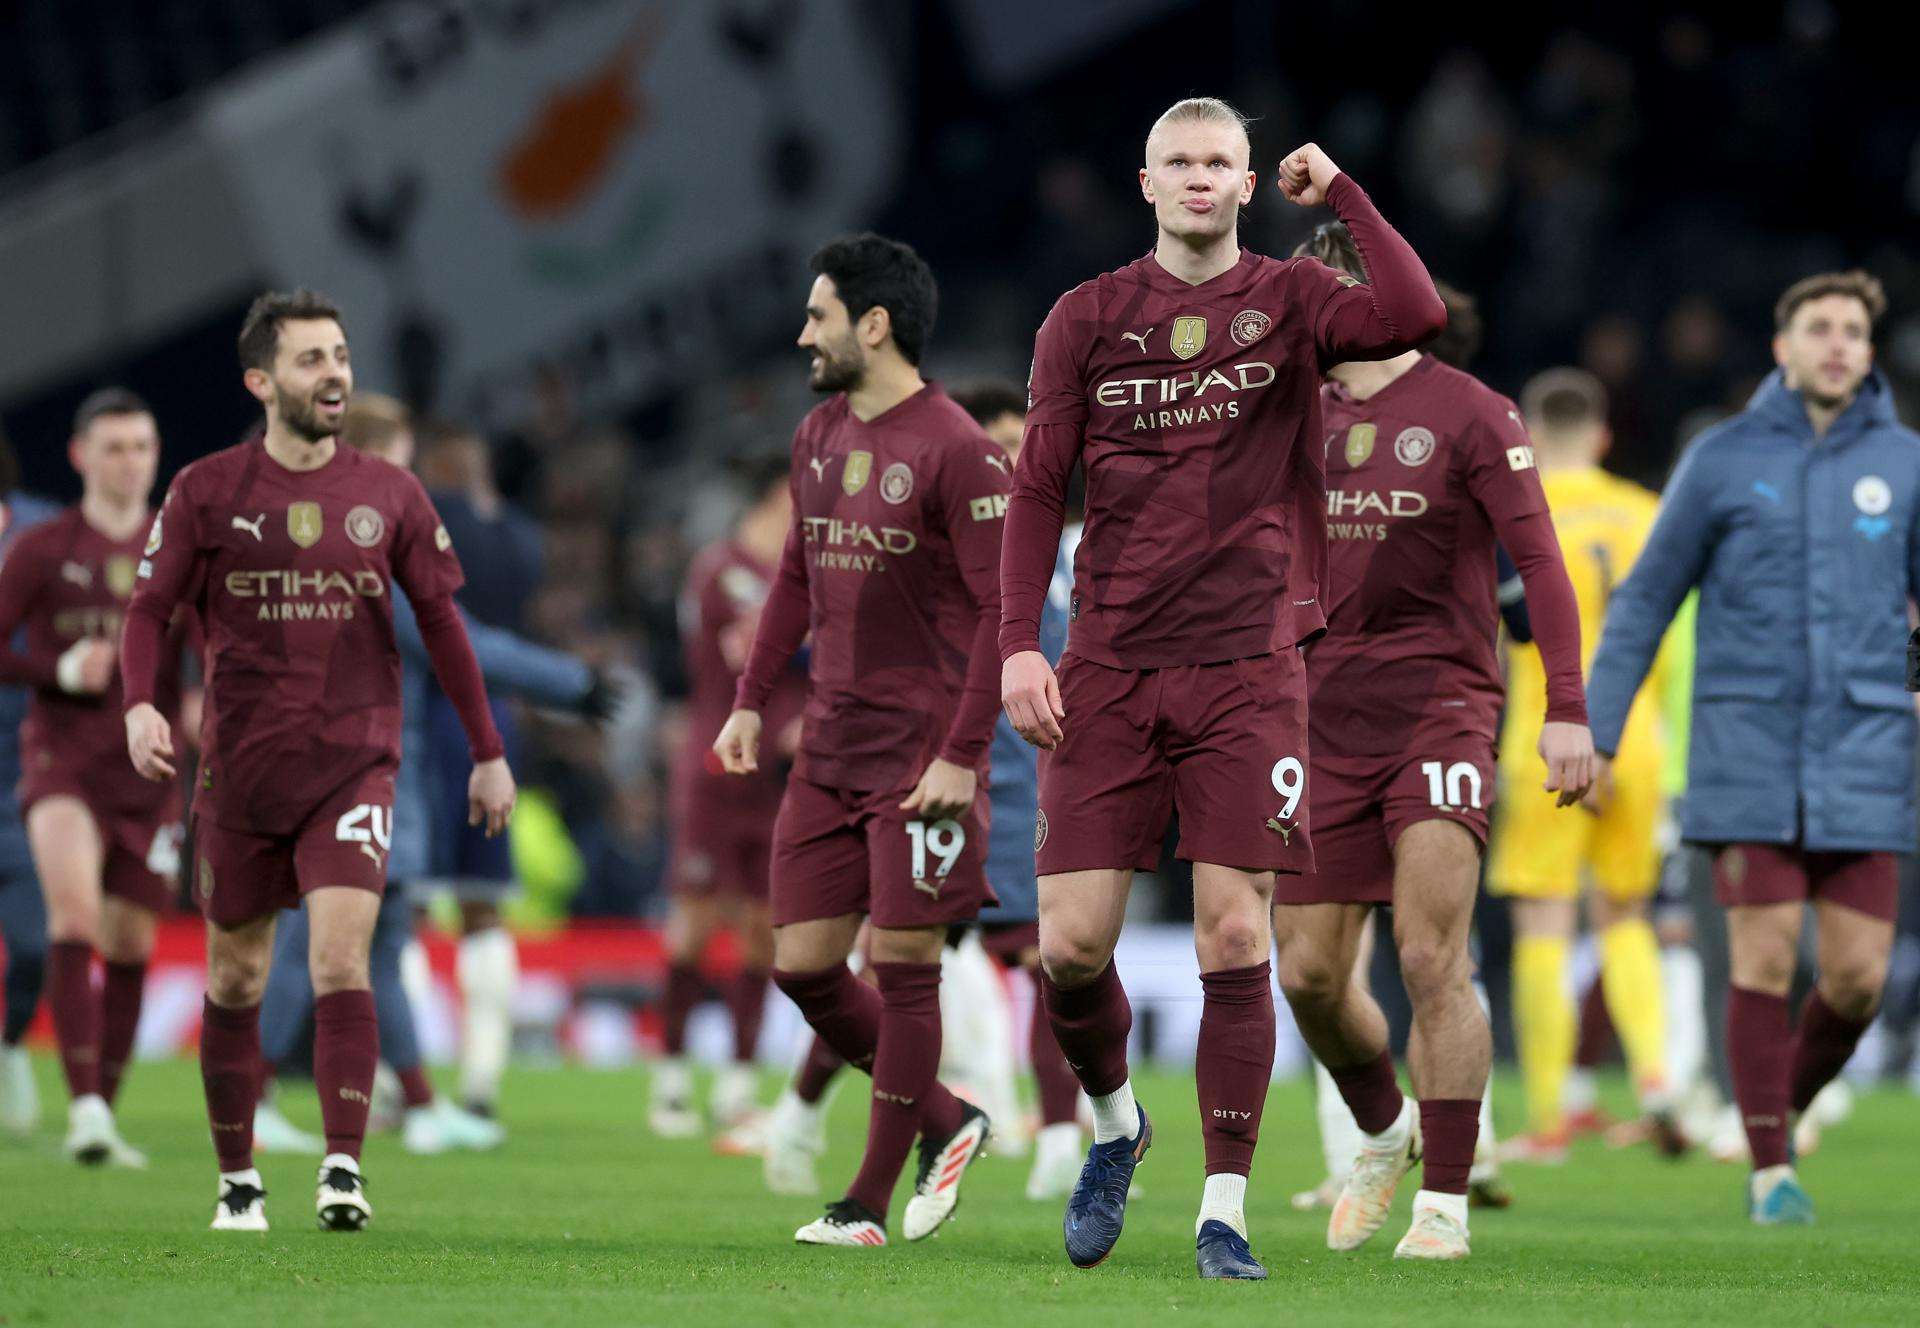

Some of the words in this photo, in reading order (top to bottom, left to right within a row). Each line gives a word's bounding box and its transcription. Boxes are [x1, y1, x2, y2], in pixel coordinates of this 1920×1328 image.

[1096, 361, 1276, 407] ETIHAD
[1133, 401, 1240, 431] AIRWAYS
[1325, 490, 1428, 517] IHAD
[1326, 524, 1387, 541] RWAYS
[225, 570, 384, 597] ETIHAD
[257, 602, 354, 620] AIRWAYS
[1271, 756, 1304, 819] 9
[905, 818, 965, 879] 19
[1213, 1109, 1251, 1120] CITY
